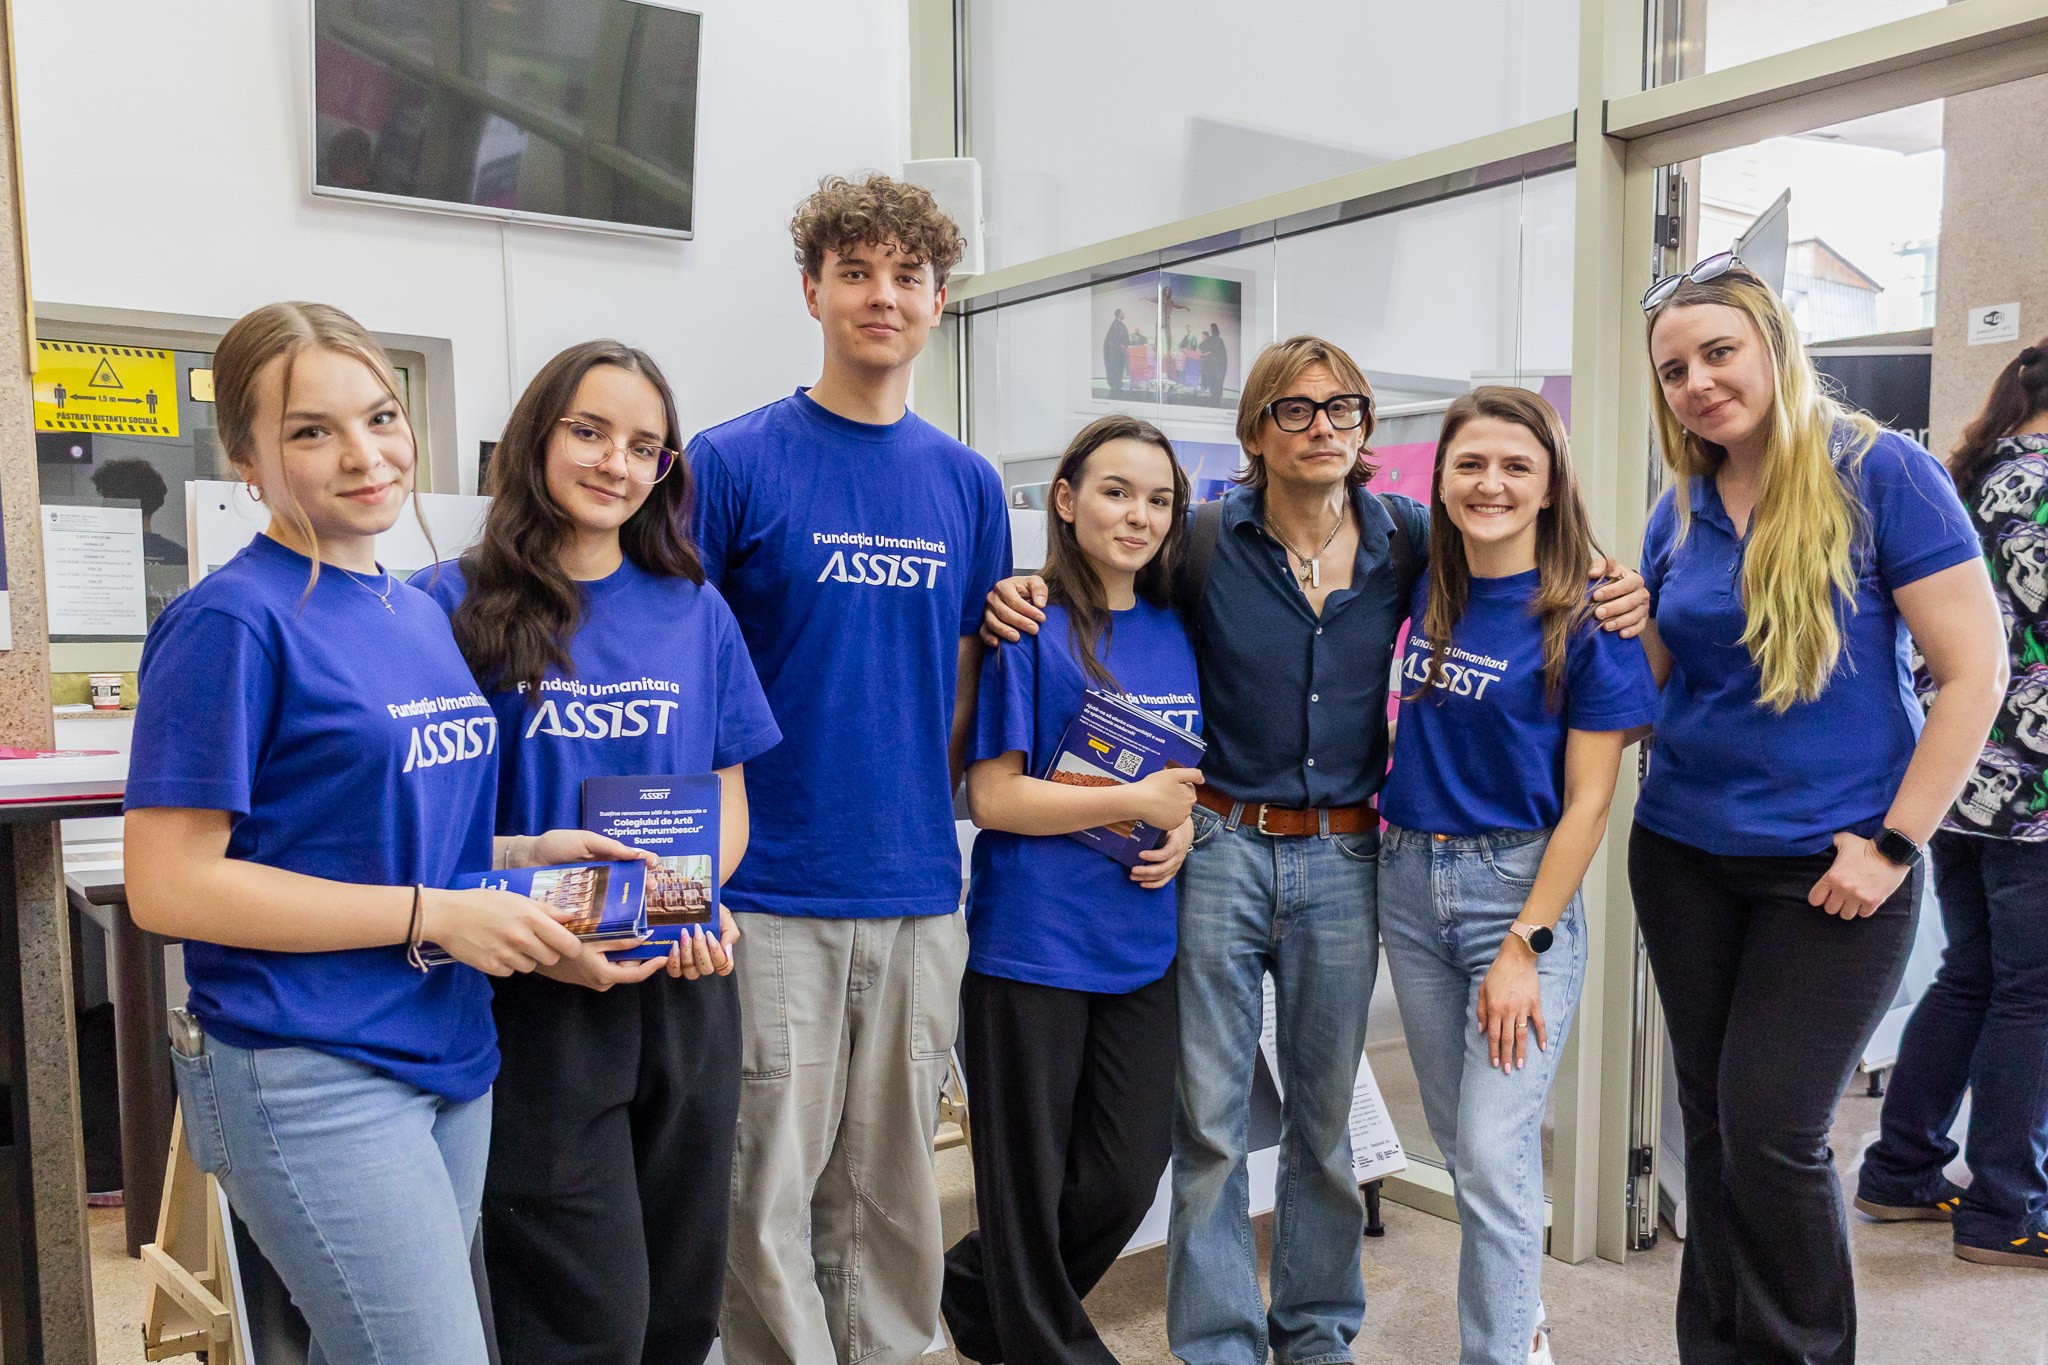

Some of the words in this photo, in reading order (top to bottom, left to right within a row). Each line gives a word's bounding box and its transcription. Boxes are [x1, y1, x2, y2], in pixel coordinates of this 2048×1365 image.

[813, 532, 873, 549] Fundația
[875, 535, 946, 554] Umanitară
[817, 550, 947, 589] ASSIST
[1452, 647, 1508, 672] Umanitară
[1402, 652, 1501, 700] ASSIST
[386, 697, 438, 720] Fundația
[1139, 693, 1196, 704] Umanitară
[525, 700, 679, 740] ASSIST
[402, 716, 498, 774] ASSIST
[639, 792, 671, 800] ASSIST
[613, 817, 660, 828] Colegiului
[660, 818, 673, 826] de
[673, 816, 694, 825] Artă
[633, 837, 674, 845] Suceava
